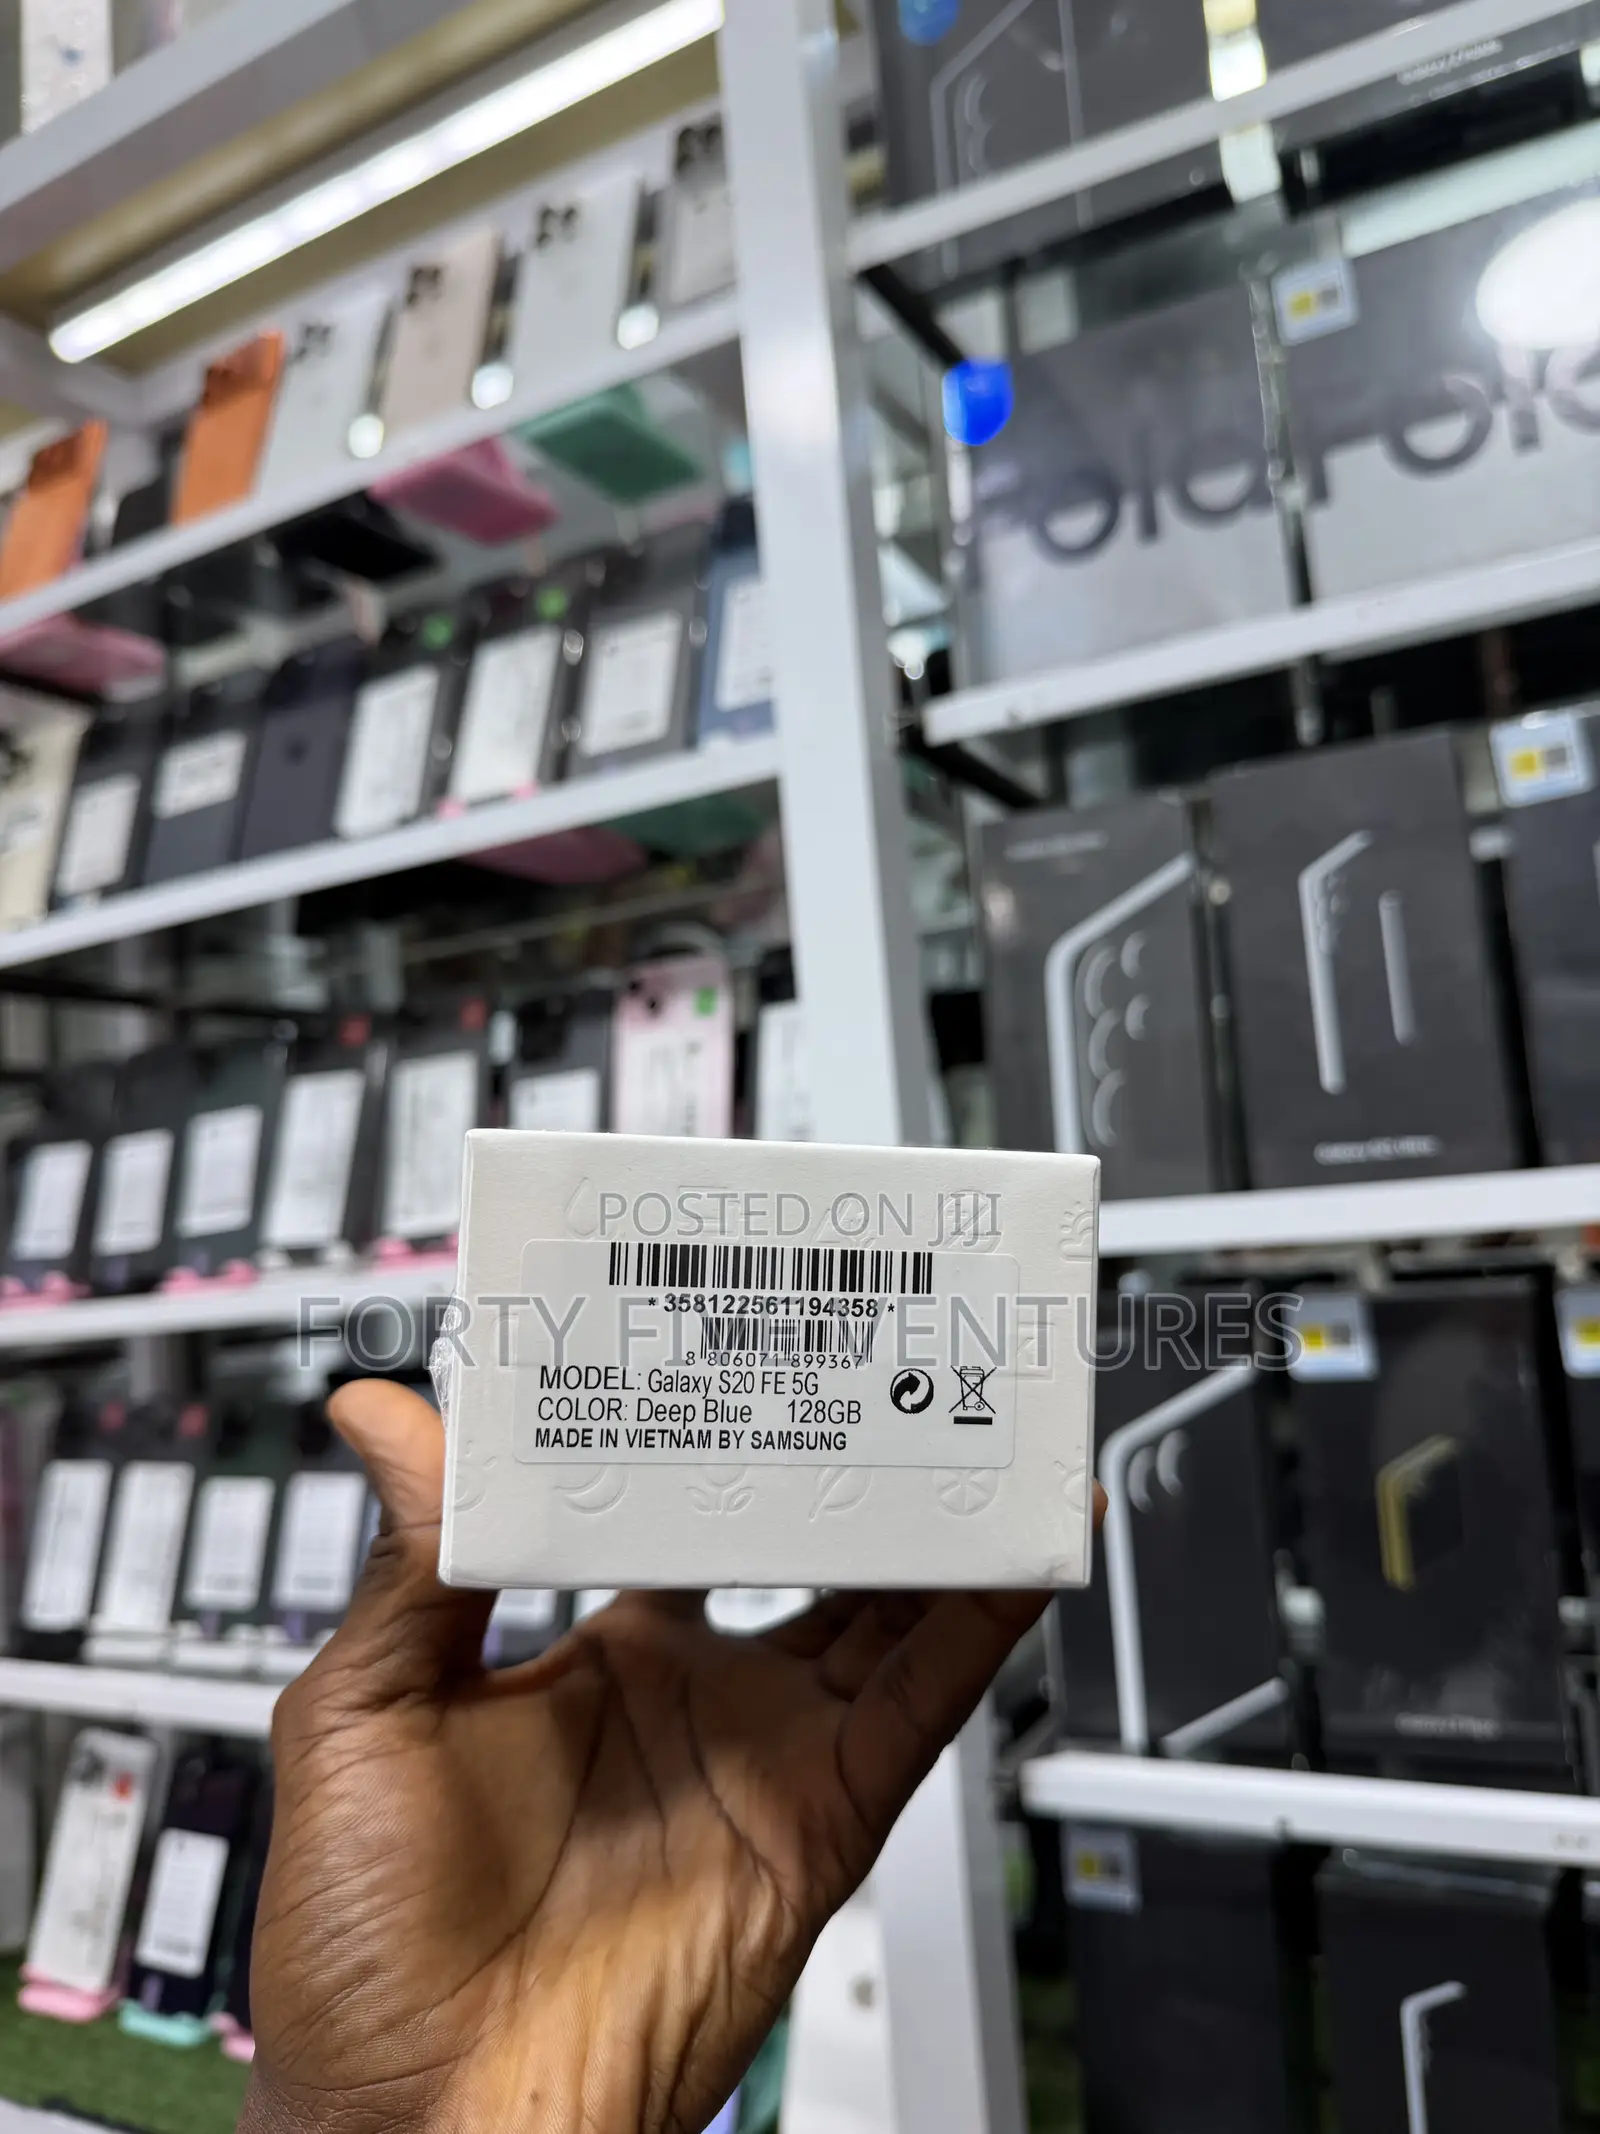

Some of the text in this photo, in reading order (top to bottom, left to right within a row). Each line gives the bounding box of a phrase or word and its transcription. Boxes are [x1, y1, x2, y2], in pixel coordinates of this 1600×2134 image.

[539, 1364, 820, 1400] MODEL: Galaxy S20 FE 5G
[537, 1396, 863, 1430] COLOR: Deep Blue 128GB
[534, 1427, 848, 1451] MADE IN VIETNAM BY SAMSUNG
